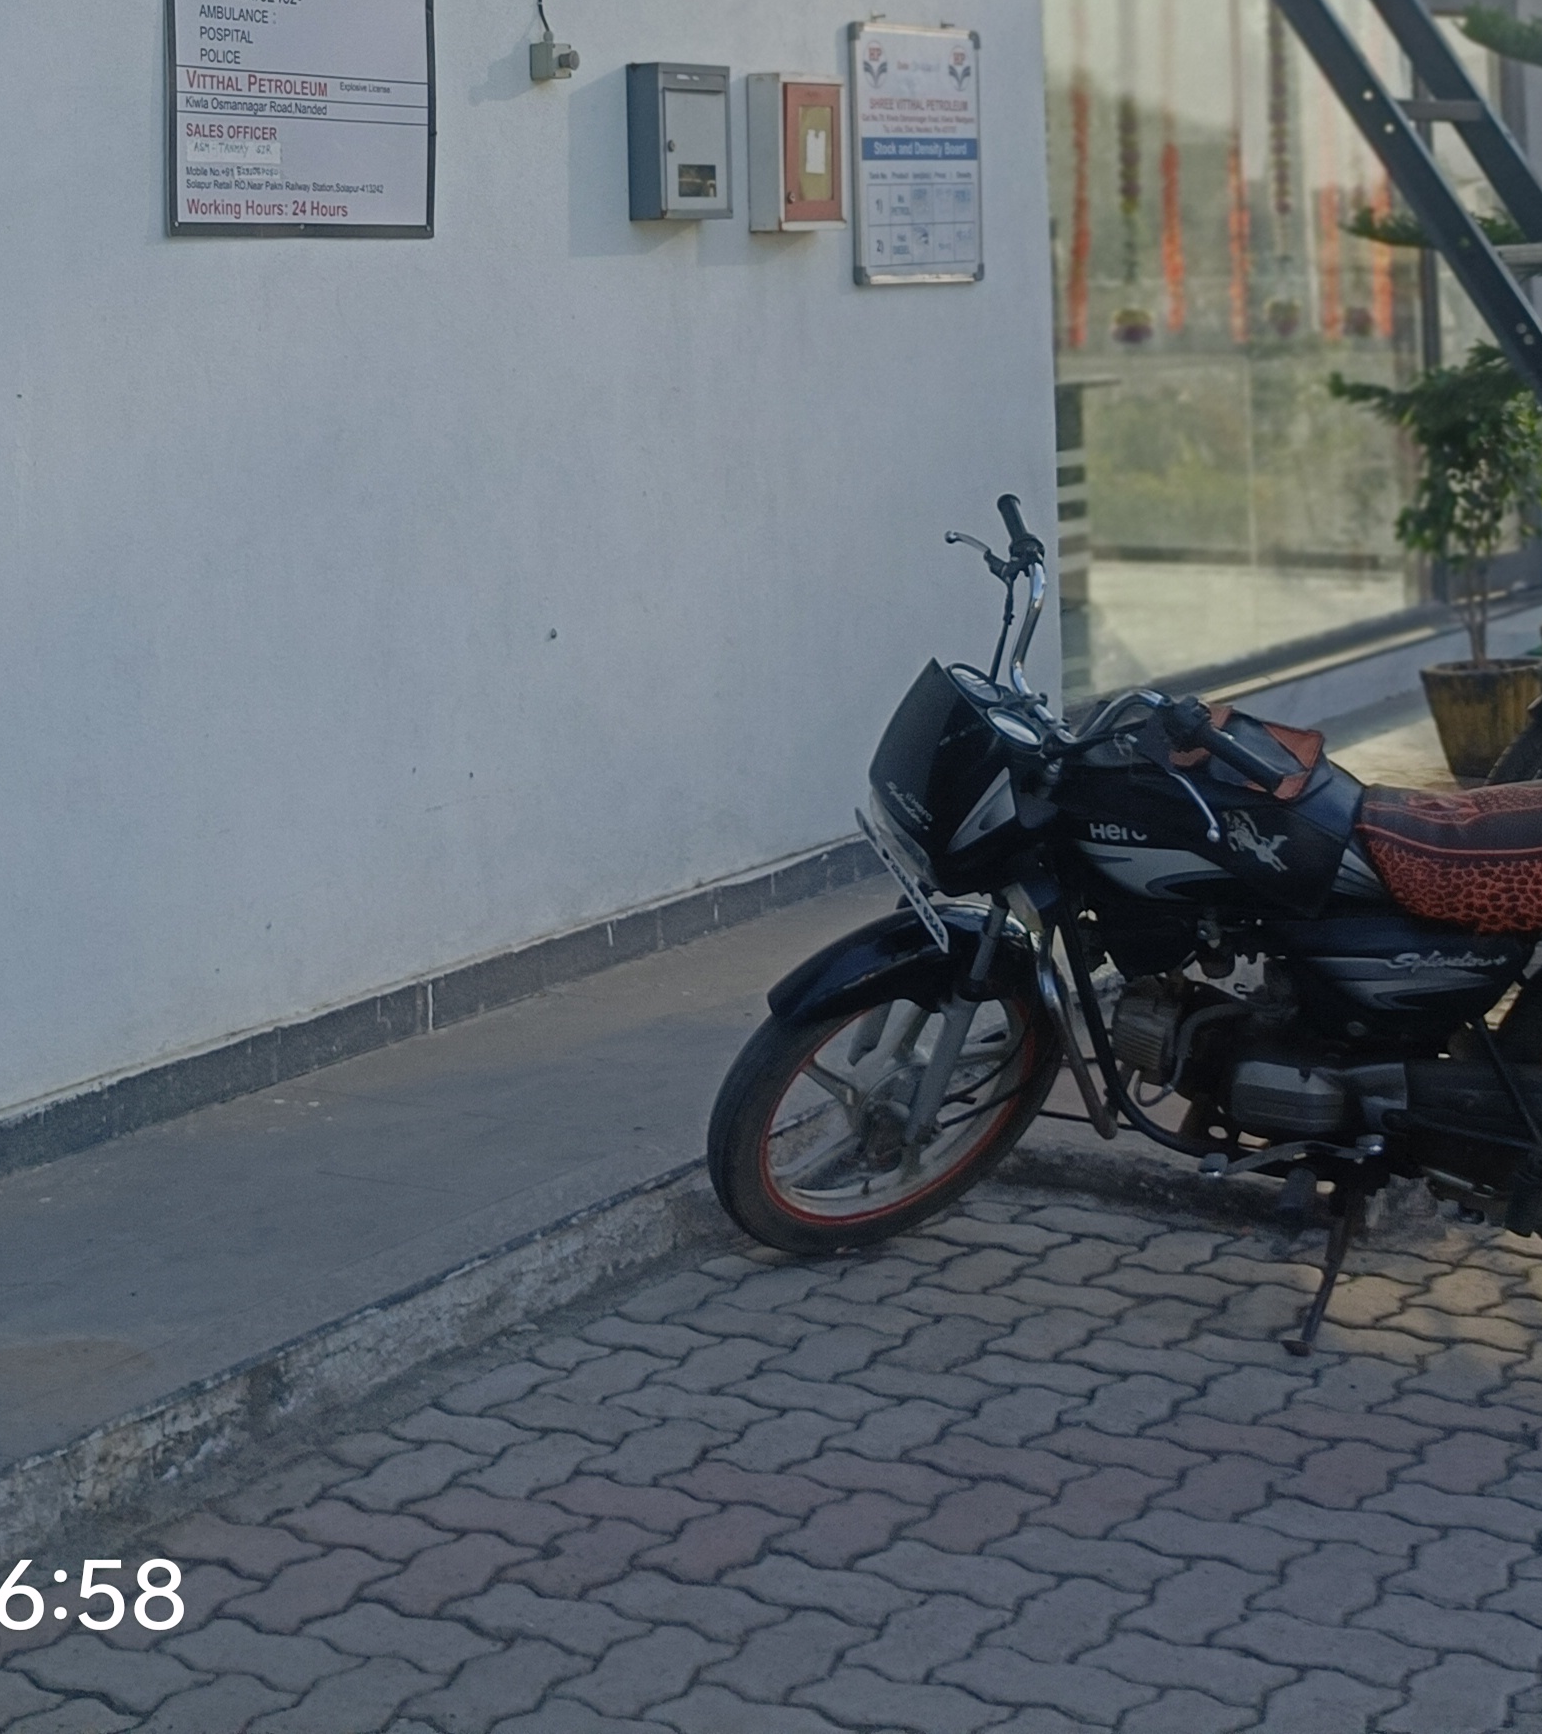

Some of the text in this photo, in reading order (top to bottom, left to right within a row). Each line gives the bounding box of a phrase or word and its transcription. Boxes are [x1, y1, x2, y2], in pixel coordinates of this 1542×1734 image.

[199, 4, 269, 24] AMBULANCE
[200, 48, 241, 65] POLICE
[186, 69, 243, 92] VITTHAL
[247, 73, 328, 97] PETROLEUM
[186, 123, 277, 141] SALES OFFICER
[874, 141, 968, 158] Stock and Density Board
[186, 198, 348, 219] Working Hours: 24 Hours
